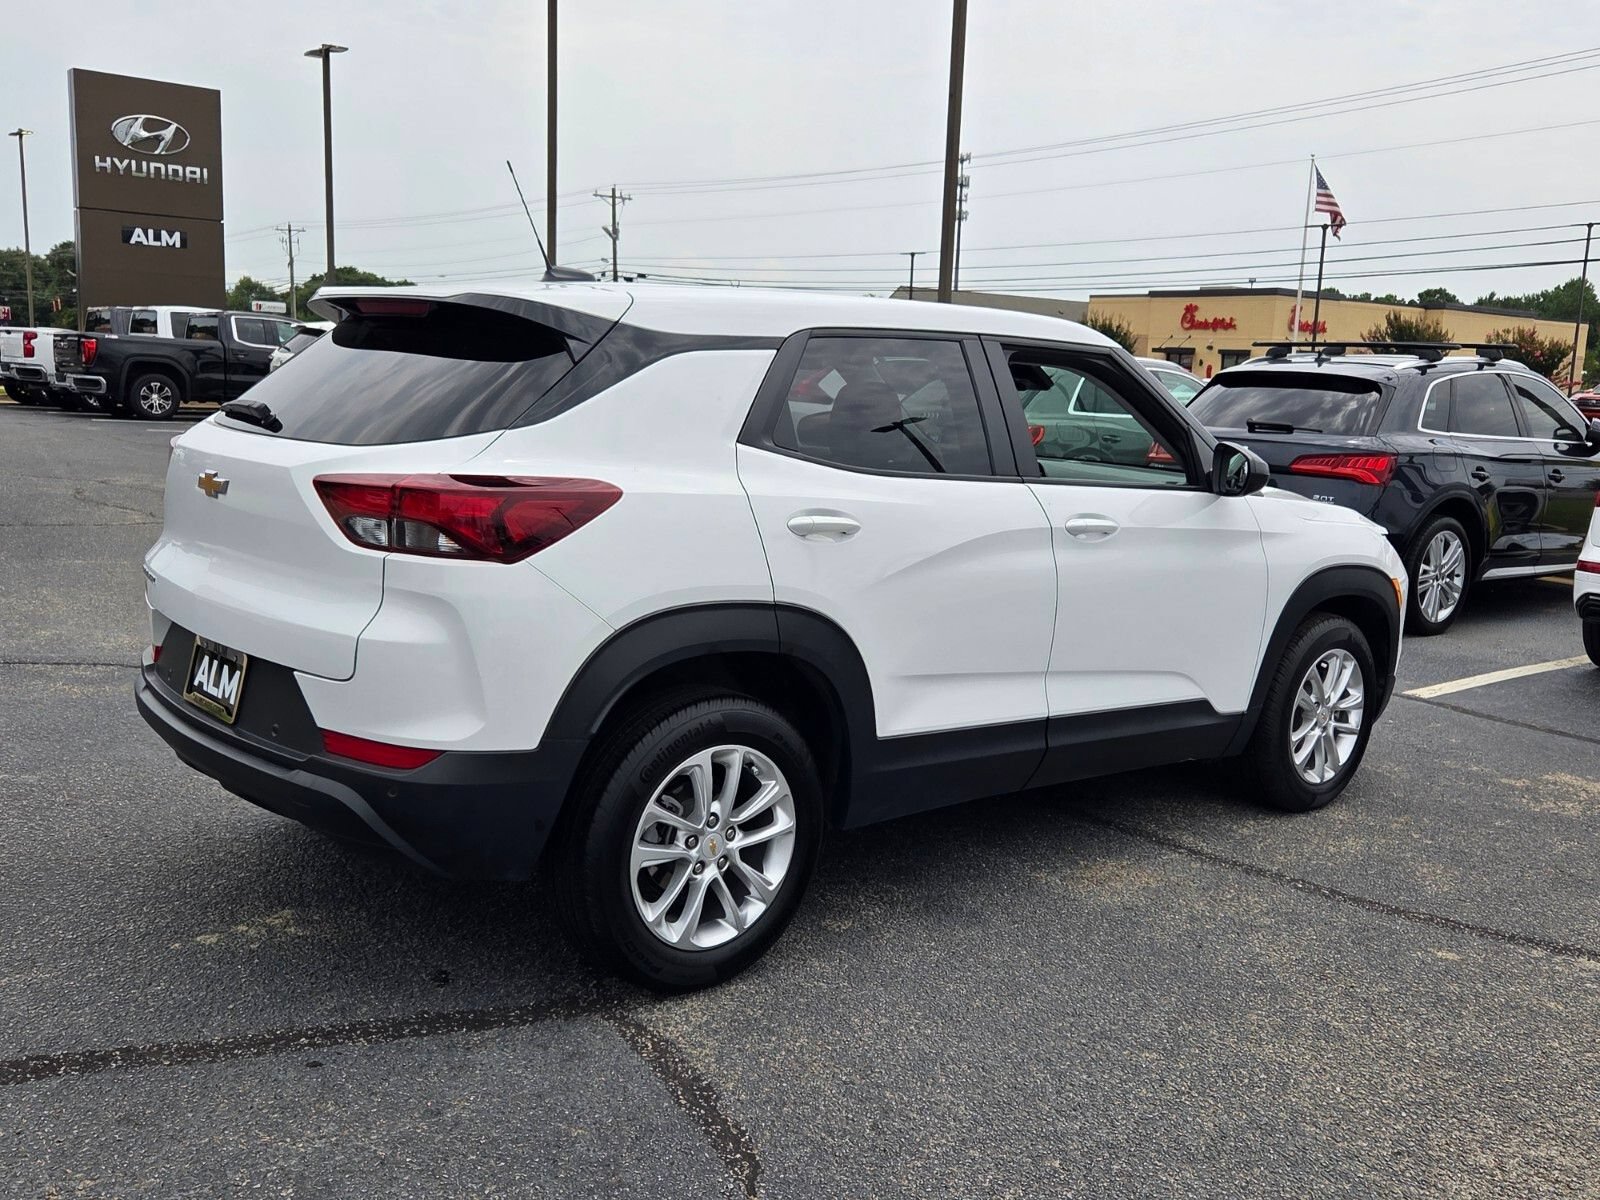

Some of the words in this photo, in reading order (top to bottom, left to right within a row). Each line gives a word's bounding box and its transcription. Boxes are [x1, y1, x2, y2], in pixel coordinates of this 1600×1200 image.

[94, 155, 208, 184] HYUNDAI
[129, 227, 181, 248] ALM
[193, 654, 241, 706] ALM
[639, 722, 706, 785] Continental
